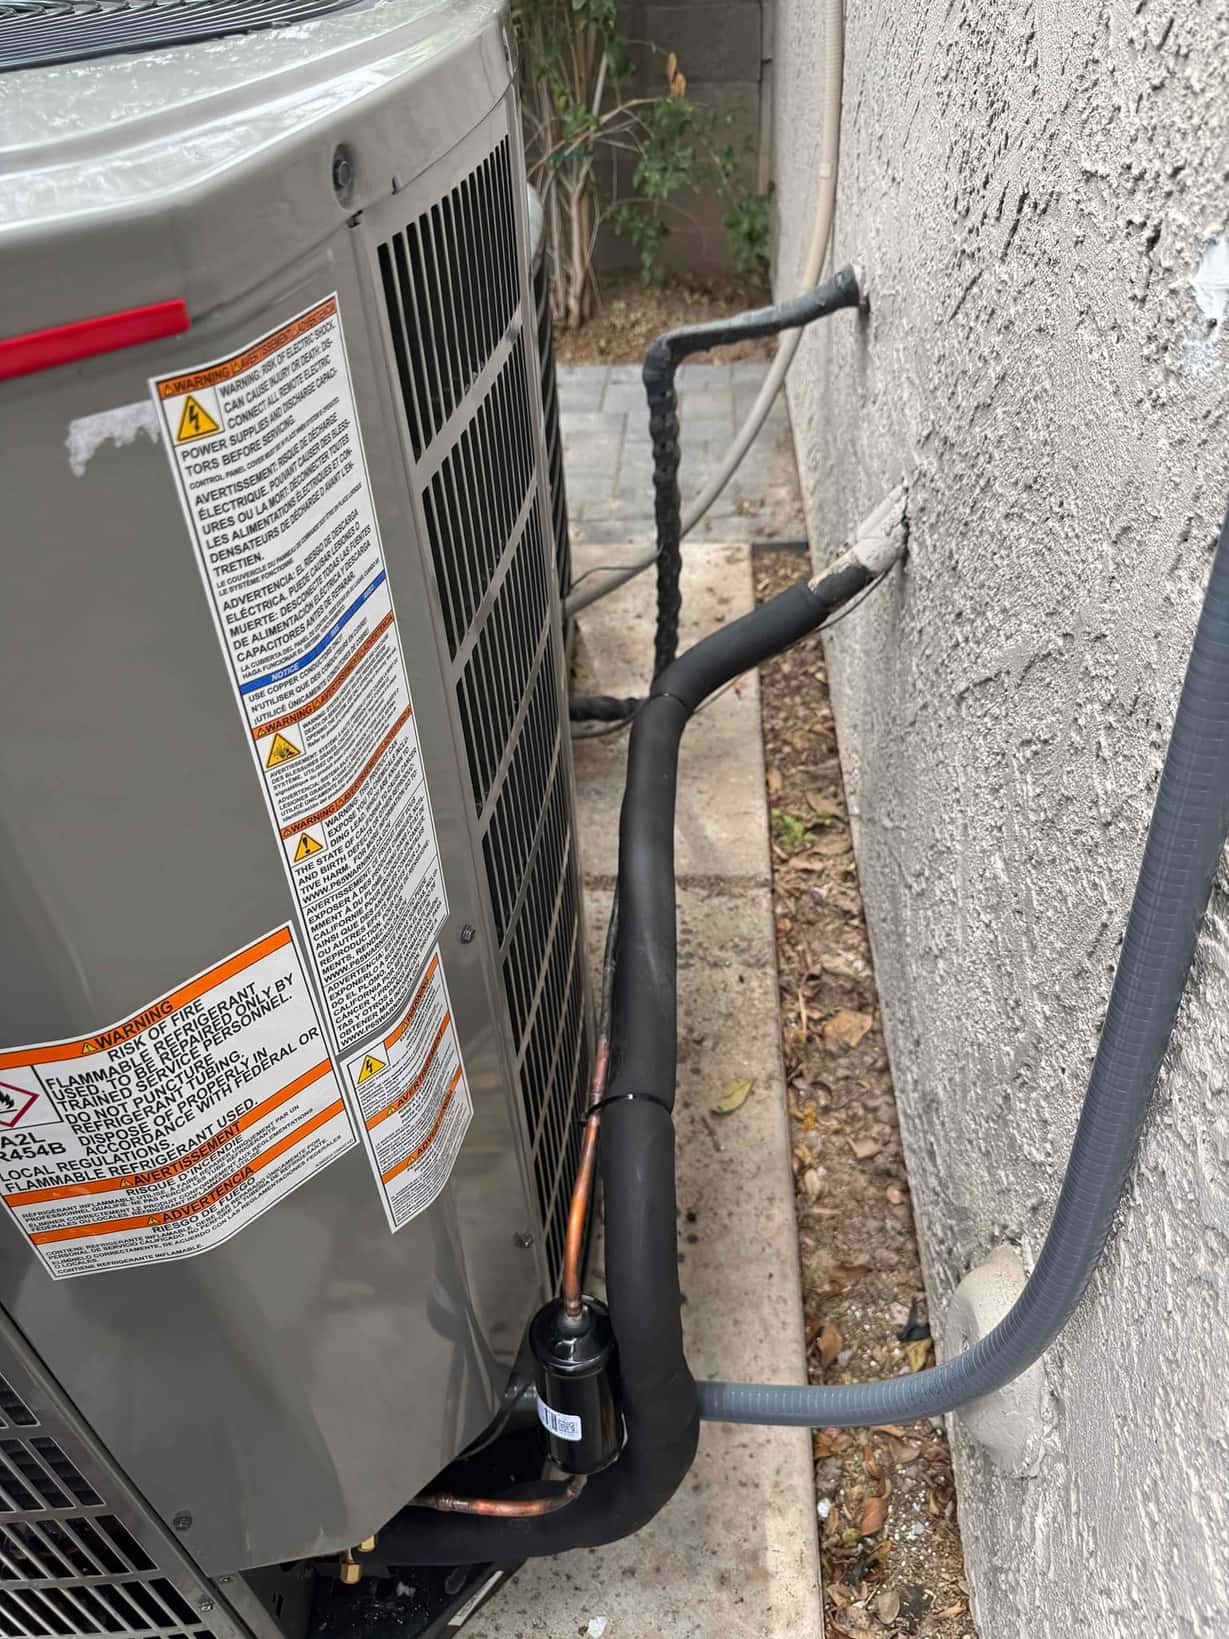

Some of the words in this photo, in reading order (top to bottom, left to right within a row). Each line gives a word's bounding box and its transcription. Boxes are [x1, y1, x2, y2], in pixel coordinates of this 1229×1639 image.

[173, 367, 229, 391] WARNING
[220, 370, 260, 398] WARNING:
[261, 360, 277, 374] RISK
[276, 352, 286, 365] OF
[285, 333, 313, 358] ELECTRIC
[223, 398, 245, 413] CAN
[246, 380, 270, 403] CAUSE
[269, 366, 290, 385] INJURY
[291, 361, 300, 375] OR
[227, 402, 268, 429] CONNECT
[267, 391, 280, 407] ALL
[279, 373, 304, 397] REMOTE
[303, 354, 331, 380] ELECTRIC
[181, 438, 227, 461] POWER
[229, 417, 269, 446] SUPPLIES
[269, 406, 282, 422] AND
[282, 384, 316, 416] DISCHARGE
[184, 458, 220, 476] TORS
[222, 439, 262, 466] BEFORE
[189, 474, 225, 490] CONTROL
[195, 461, 277, 506] AVERTISSEMENT:
[277, 442, 300, 468] RISQUE
[300, 435, 309, 447] DE
[201, 516, 236, 535] URES
[237, 510, 254, 523] OU
[255, 502, 269, 516] LA
[329, 433, 350, 456] TOUTES
[268, 461, 297, 491] POUVANT
[297, 442, 321, 467] CAUSER
[320, 433, 331, 450] DES
[206, 532, 230, 550] LES
[232, 496, 297, 541] ALIMENTATIONS
[332, 456, 339, 470] ET
[209, 527, 280, 564] DENSATEURS
[279, 518, 290, 534] DE
[324, 470, 341, 492] AVANT
[213, 552, 264, 576] TRETIEN.
[223, 572, 296, 611] ADVERTENCIA:
[295, 563, 305, 576] EL
[303, 541, 324, 566] RIESGO
[323, 534, 332, 547] DE
[331, 508, 359, 538] DESCARGA
[229, 612, 279, 638] MUERTE:
[279, 577, 323, 617] DESCONECTE
[322, 556, 341, 581] TODAS
[340, 547, 350, 564] LAS
[349, 524, 371, 554] FUENTES
[288, 571, 310, 596] PUEDE
[310, 550, 332, 576] CAUSAR
[331, 526, 355, 555] LESIONES
[233, 637, 250, 650] DE
[340, 564, 347, 576] Y
[344, 540, 371, 572] DESCARGA
[237, 624, 307, 663] CAPACITORES
[306, 604, 325, 628] ANTES
[323, 595, 333, 608] DE
[248, 691, 266, 702] USE
[267, 675, 299, 695] COPPER
[271, 662, 300, 681] NOTICE
[295, 681, 310, 693] QUE
[264, 705, 313, 733] WARNING
[291, 805, 335, 833] WARNING
[330, 829, 350, 847] DING
[295, 861, 315, 876] THE
[316, 845, 344, 866] STATE
[344, 836, 355, 849] OF
[298, 870, 319, 886] AND
[319, 854, 347, 875] BIRTH
[300, 880, 321, 894] TIVE
[308, 896, 351, 925] EXPOSER
[315, 933, 339, 950] AINSI
[340, 921, 360, 936] QUE
[317, 947, 331, 958] OU
[95, 1001, 173, 1048] WARNING
[107, 1035, 147, 1062] RISK
[148, 1021, 168, 1040] OF
[171, 998, 205, 1027] FIRE
[331, 997, 344, 1009] DO
[336, 1018, 354, 1031] TAS
[45, 1049, 152, 1090] FLAMMABLE
[153, 982, 256, 1054] REFRIGERANT
[52, 1084, 105, 1101] USED.
[106, 1074, 130, 1090] TO
[134, 1060, 158, 1080] BE
[159, 1012, 232, 1066] REPAIRED
[235, 986, 271, 1017] ONLY
[275, 972, 293, 993] BY
[56, 1087, 132, 1112] TRAINED
[136, 1046, 200, 1092] SERVICE
[202, 993, 293, 1052] PERSONNEL.
[65, 1111, 91, 1125] DO
[94, 1101, 128, 1120] NOT
[133, 1053, 215, 1109] PUNCTURE
[71, 1086, 184, 1135] REFRIGERANT
[185, 1050, 245, 1090] TUBING.
[78, 1120, 151, 1146] DISPOSE
[153, 1108, 174, 1127] OF
[177, 1057, 250, 1114] PROPERLY
[253, 1047, 268, 1063] IN
[86, 1108, 196, 1157] ACCORDANCE
[196, 1083, 233, 1113] WITH
[234, 1043, 298, 1088] FEDERAL
[298, 1027, 320, 1046] OR
[0, 1132, 46, 1149] A2L
[0, 1165, 56, 1182] LOCAL
[56, 1139, 175, 1172] REGULATIONS.
[5, 1168, 107, 1193] FLAMMABLE
[107, 1124, 214, 1177] REFRIGERANT
[216, 1098, 258, 1129] USED.
[126, 1178, 177, 1196] RISQUE
[178, 1135, 244, 1181] D'INCENDIE
[134, 1123, 241, 1185] AVERTISSEMENT
[152, 1215, 199, 1234] RIESGO
[201, 1204, 218, 1218] DE
[219, 1177, 255, 1207] FUEGO
[162, 1166, 255, 1224] ADVERTENCIA
